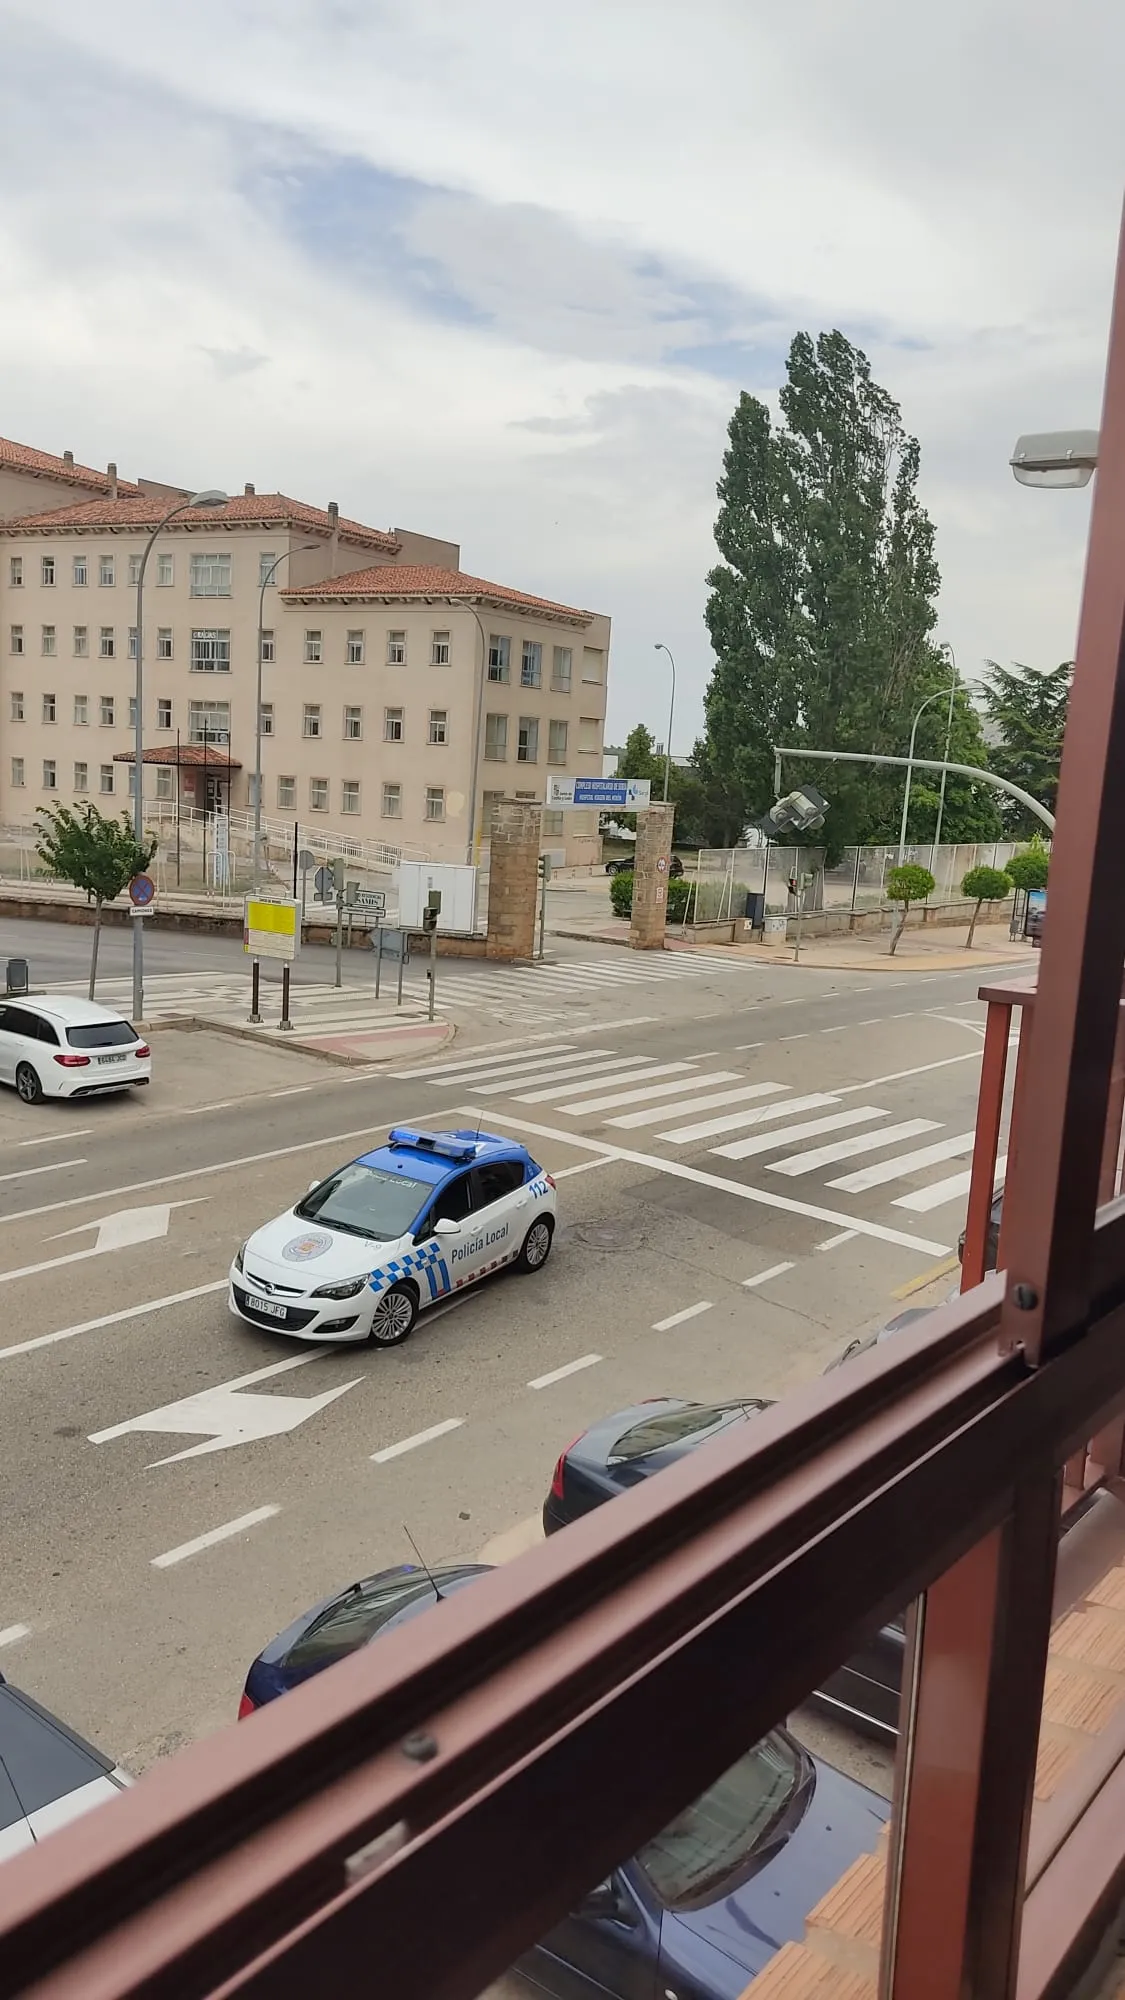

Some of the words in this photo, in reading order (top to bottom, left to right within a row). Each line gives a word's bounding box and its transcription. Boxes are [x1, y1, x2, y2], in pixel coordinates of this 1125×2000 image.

[529, 1180, 549, 1200] 112
[451, 1237, 484, 1264] Policía
[486, 1222, 509, 1246] Local
[250, 1297, 269, 1311] 8015
[270, 1305, 286, 1317] JFG
